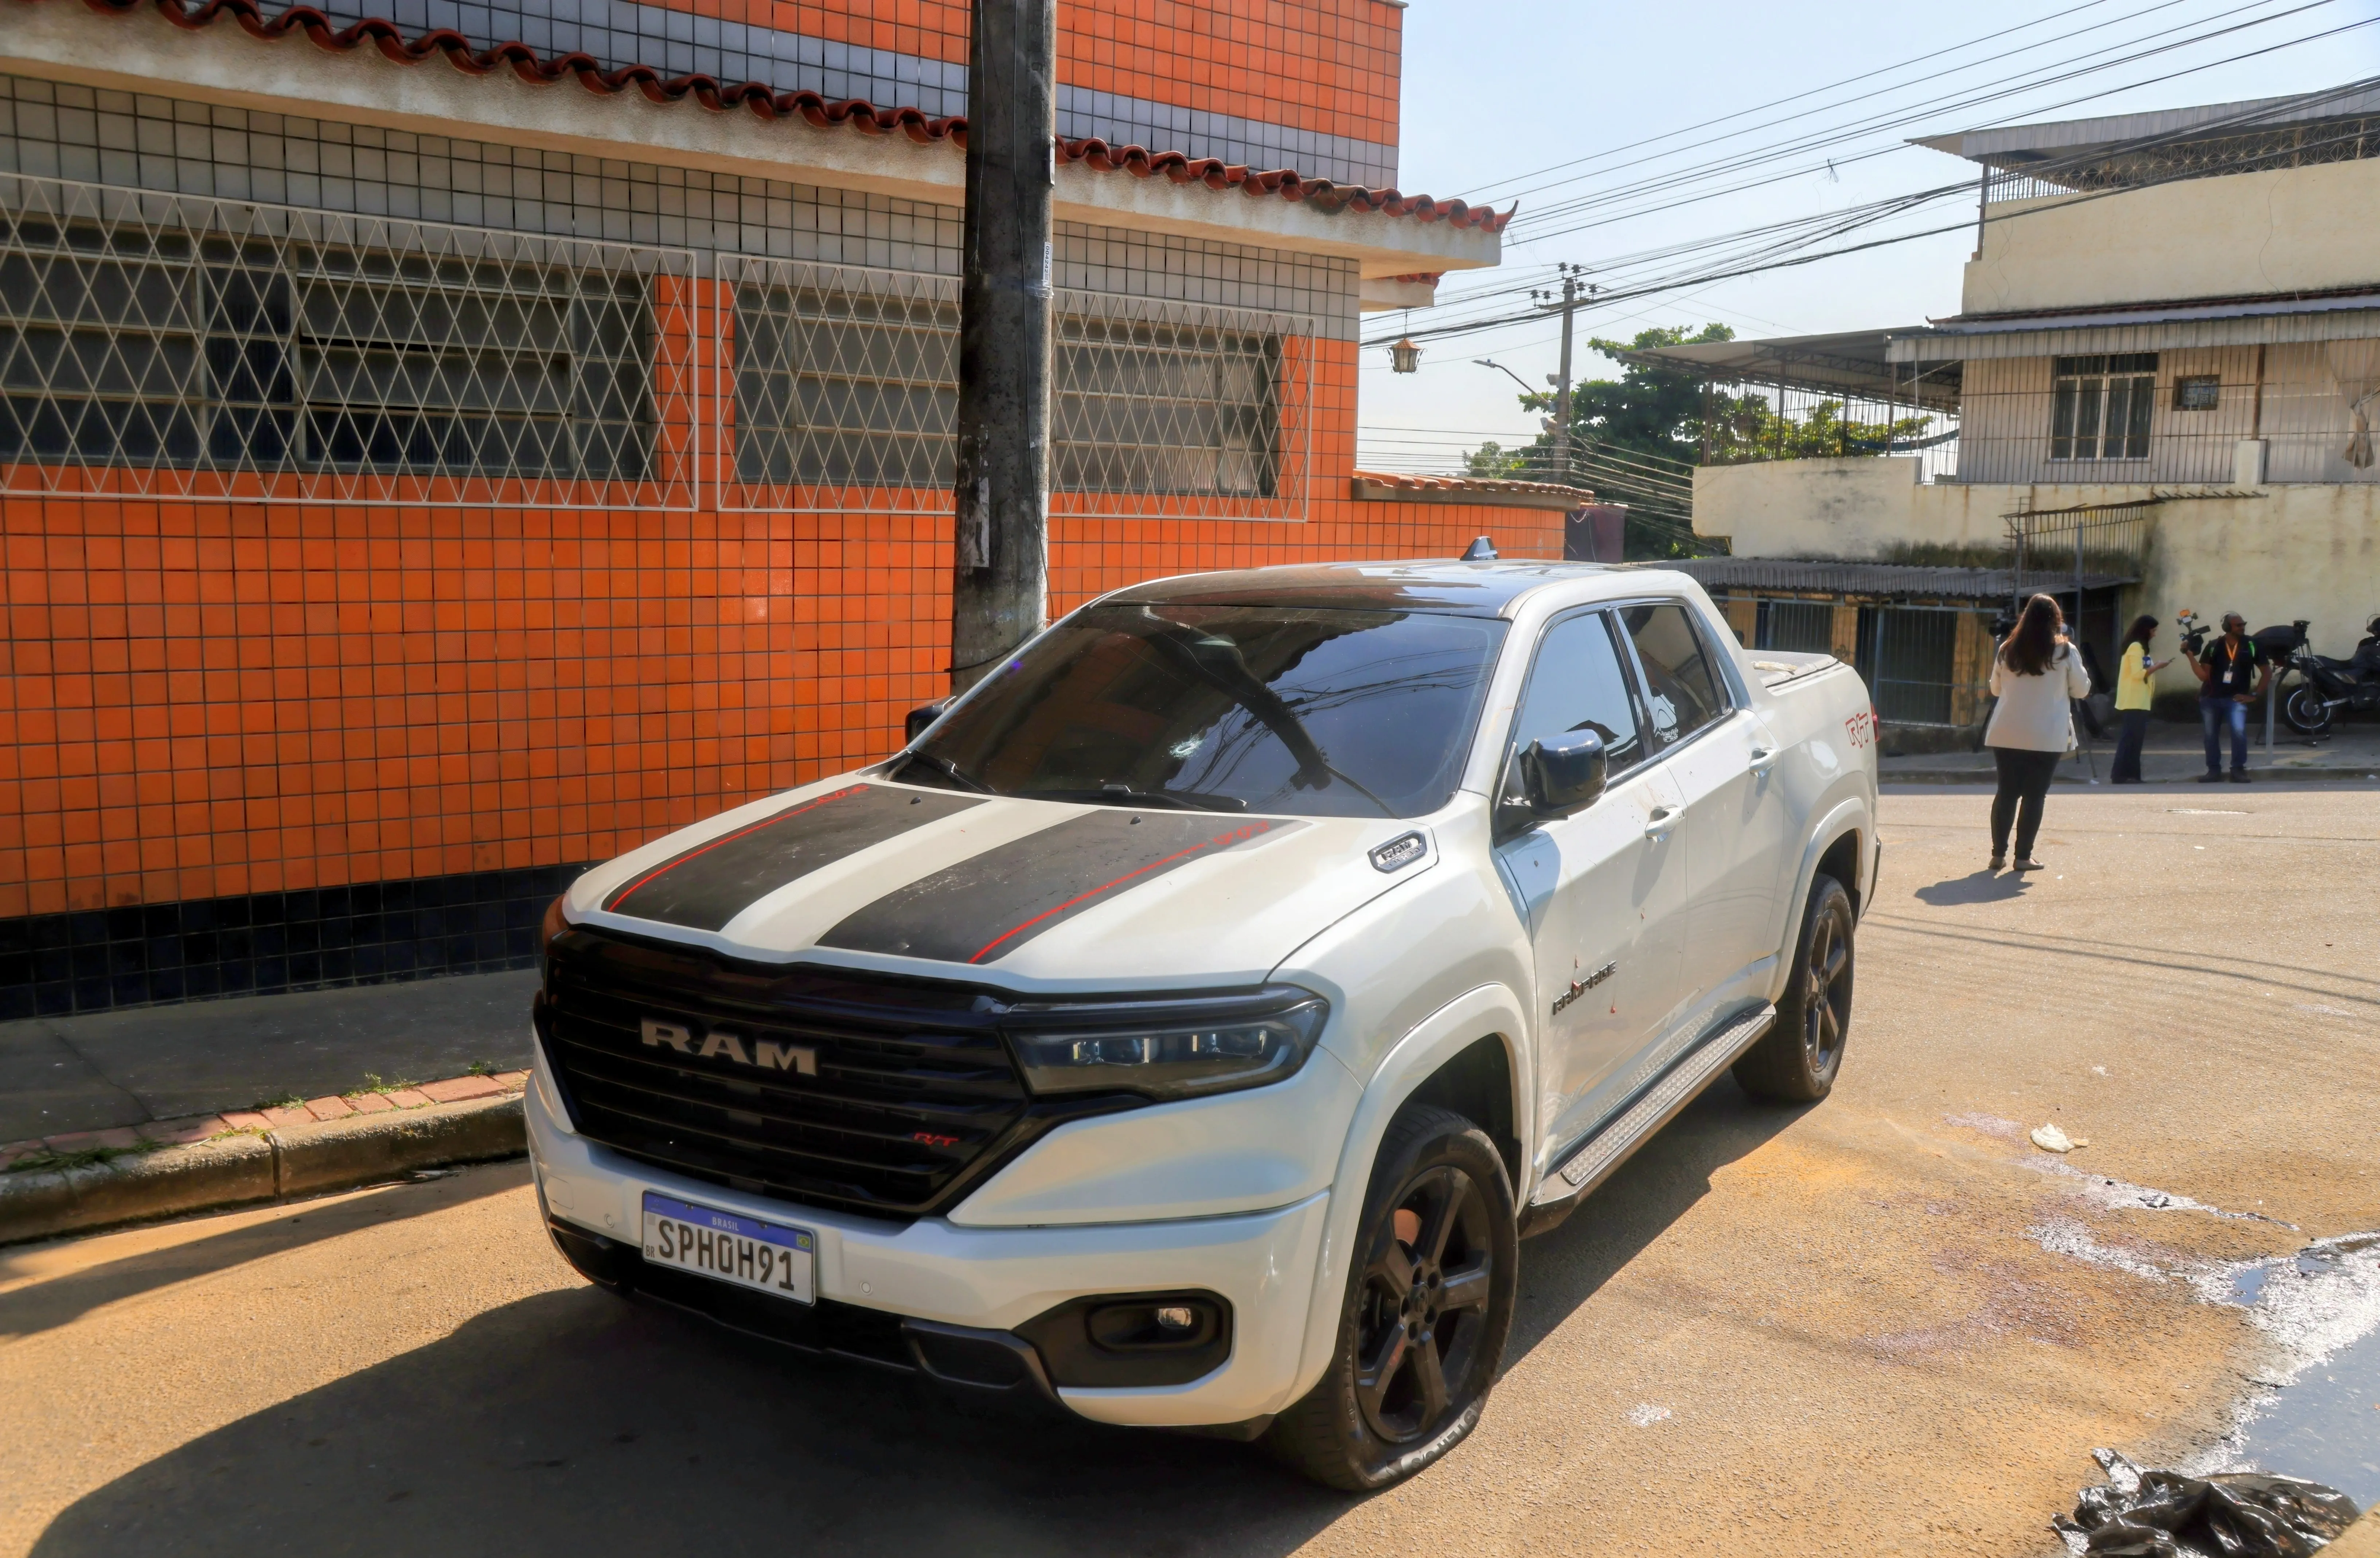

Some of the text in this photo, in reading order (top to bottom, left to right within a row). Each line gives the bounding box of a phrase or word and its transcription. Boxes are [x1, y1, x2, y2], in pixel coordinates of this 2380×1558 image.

[1381, 840, 1413, 860] RAM
[1553, 960, 1616, 1016] RAMPAGE
[640, 1018, 817, 1076] RAM
[712, 1217, 739, 1231] BRASIL
[645, 1245, 655, 1258] BR
